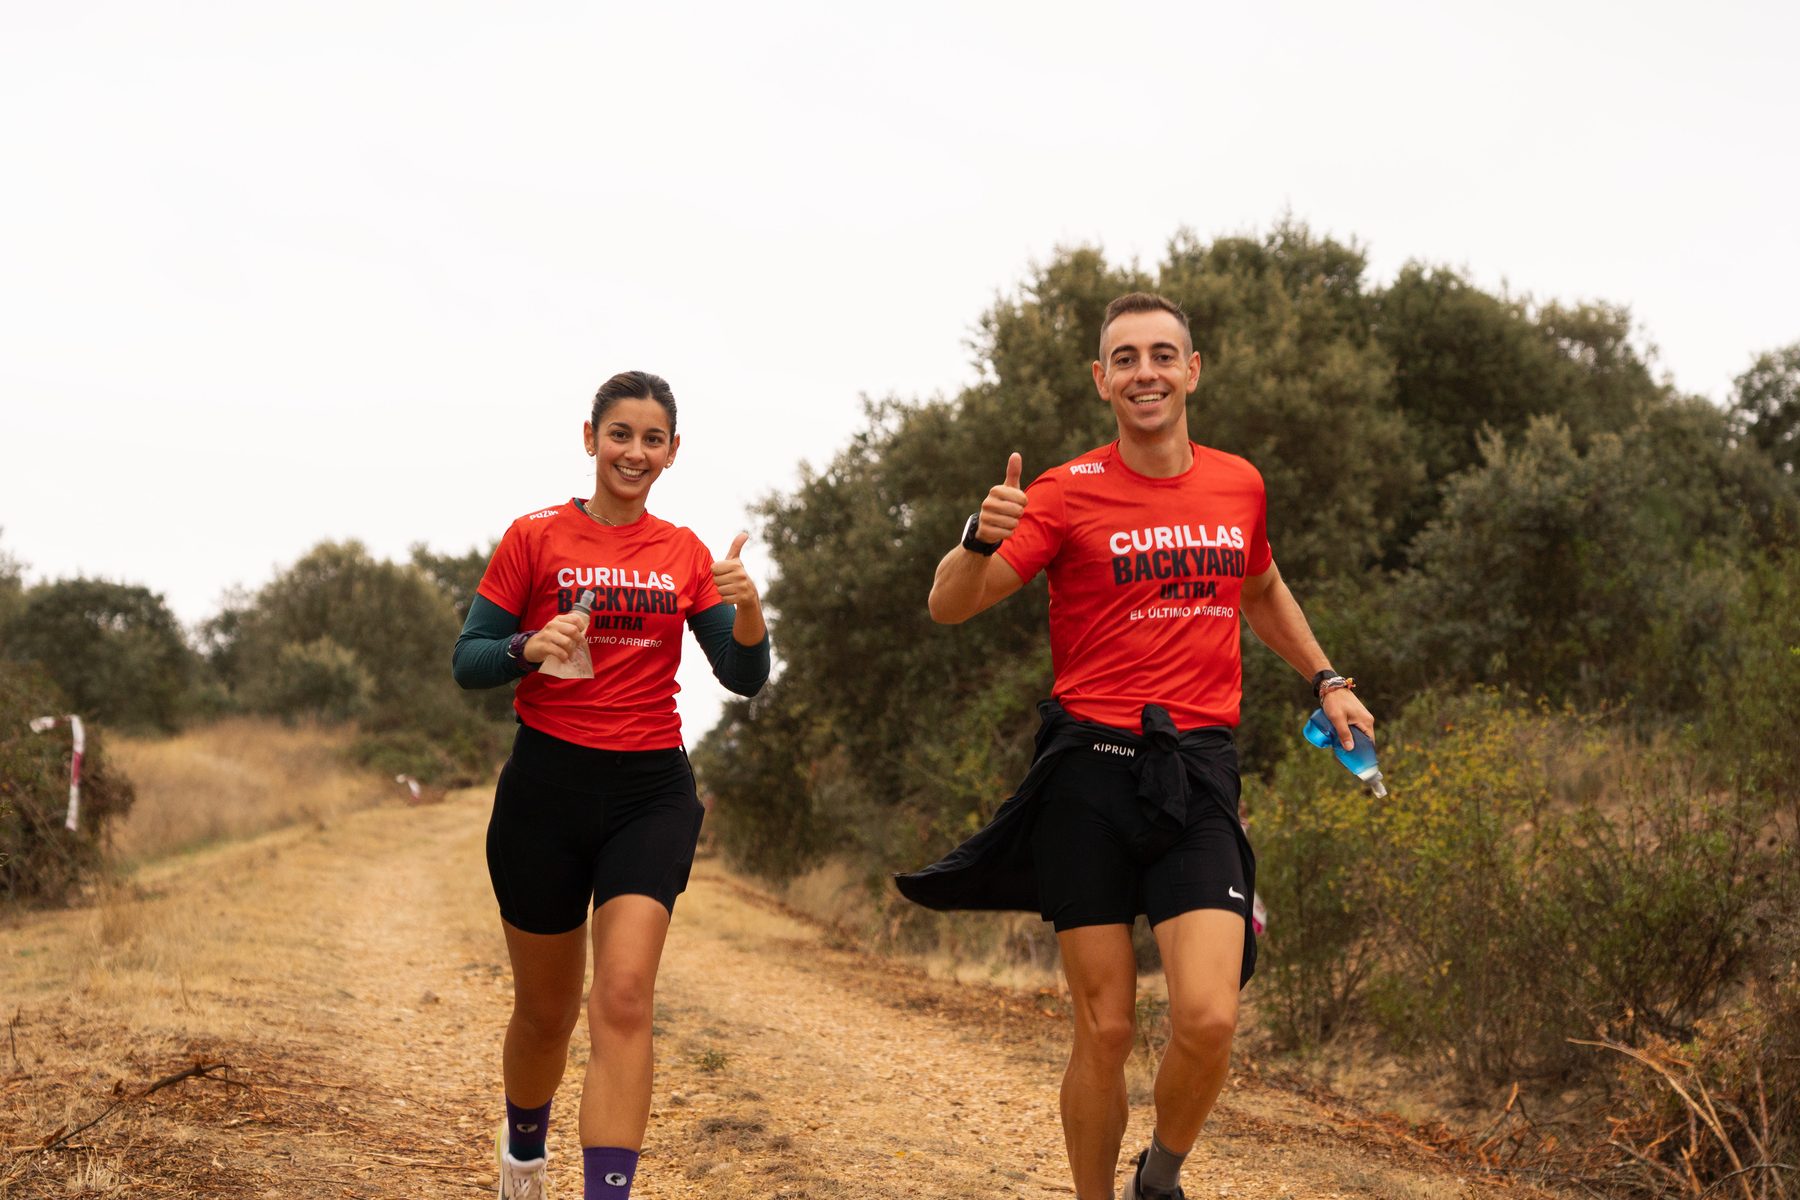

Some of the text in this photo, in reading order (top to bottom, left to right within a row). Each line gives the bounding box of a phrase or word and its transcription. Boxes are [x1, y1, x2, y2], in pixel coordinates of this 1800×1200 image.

[1109, 524, 1245, 555] CURILLAS
[1111, 547, 1246, 586] BACKYARD
[557, 567, 676, 591] CURILLAS
[1159, 581, 1217, 601] ULTRA
[1129, 605, 1234, 621] EL ÚLTIMO ARRIERO
[594, 615, 643, 631] ULTRA
[618, 636, 662, 648] ARRIERO
[1093, 741, 1136, 758] KIPRUN
